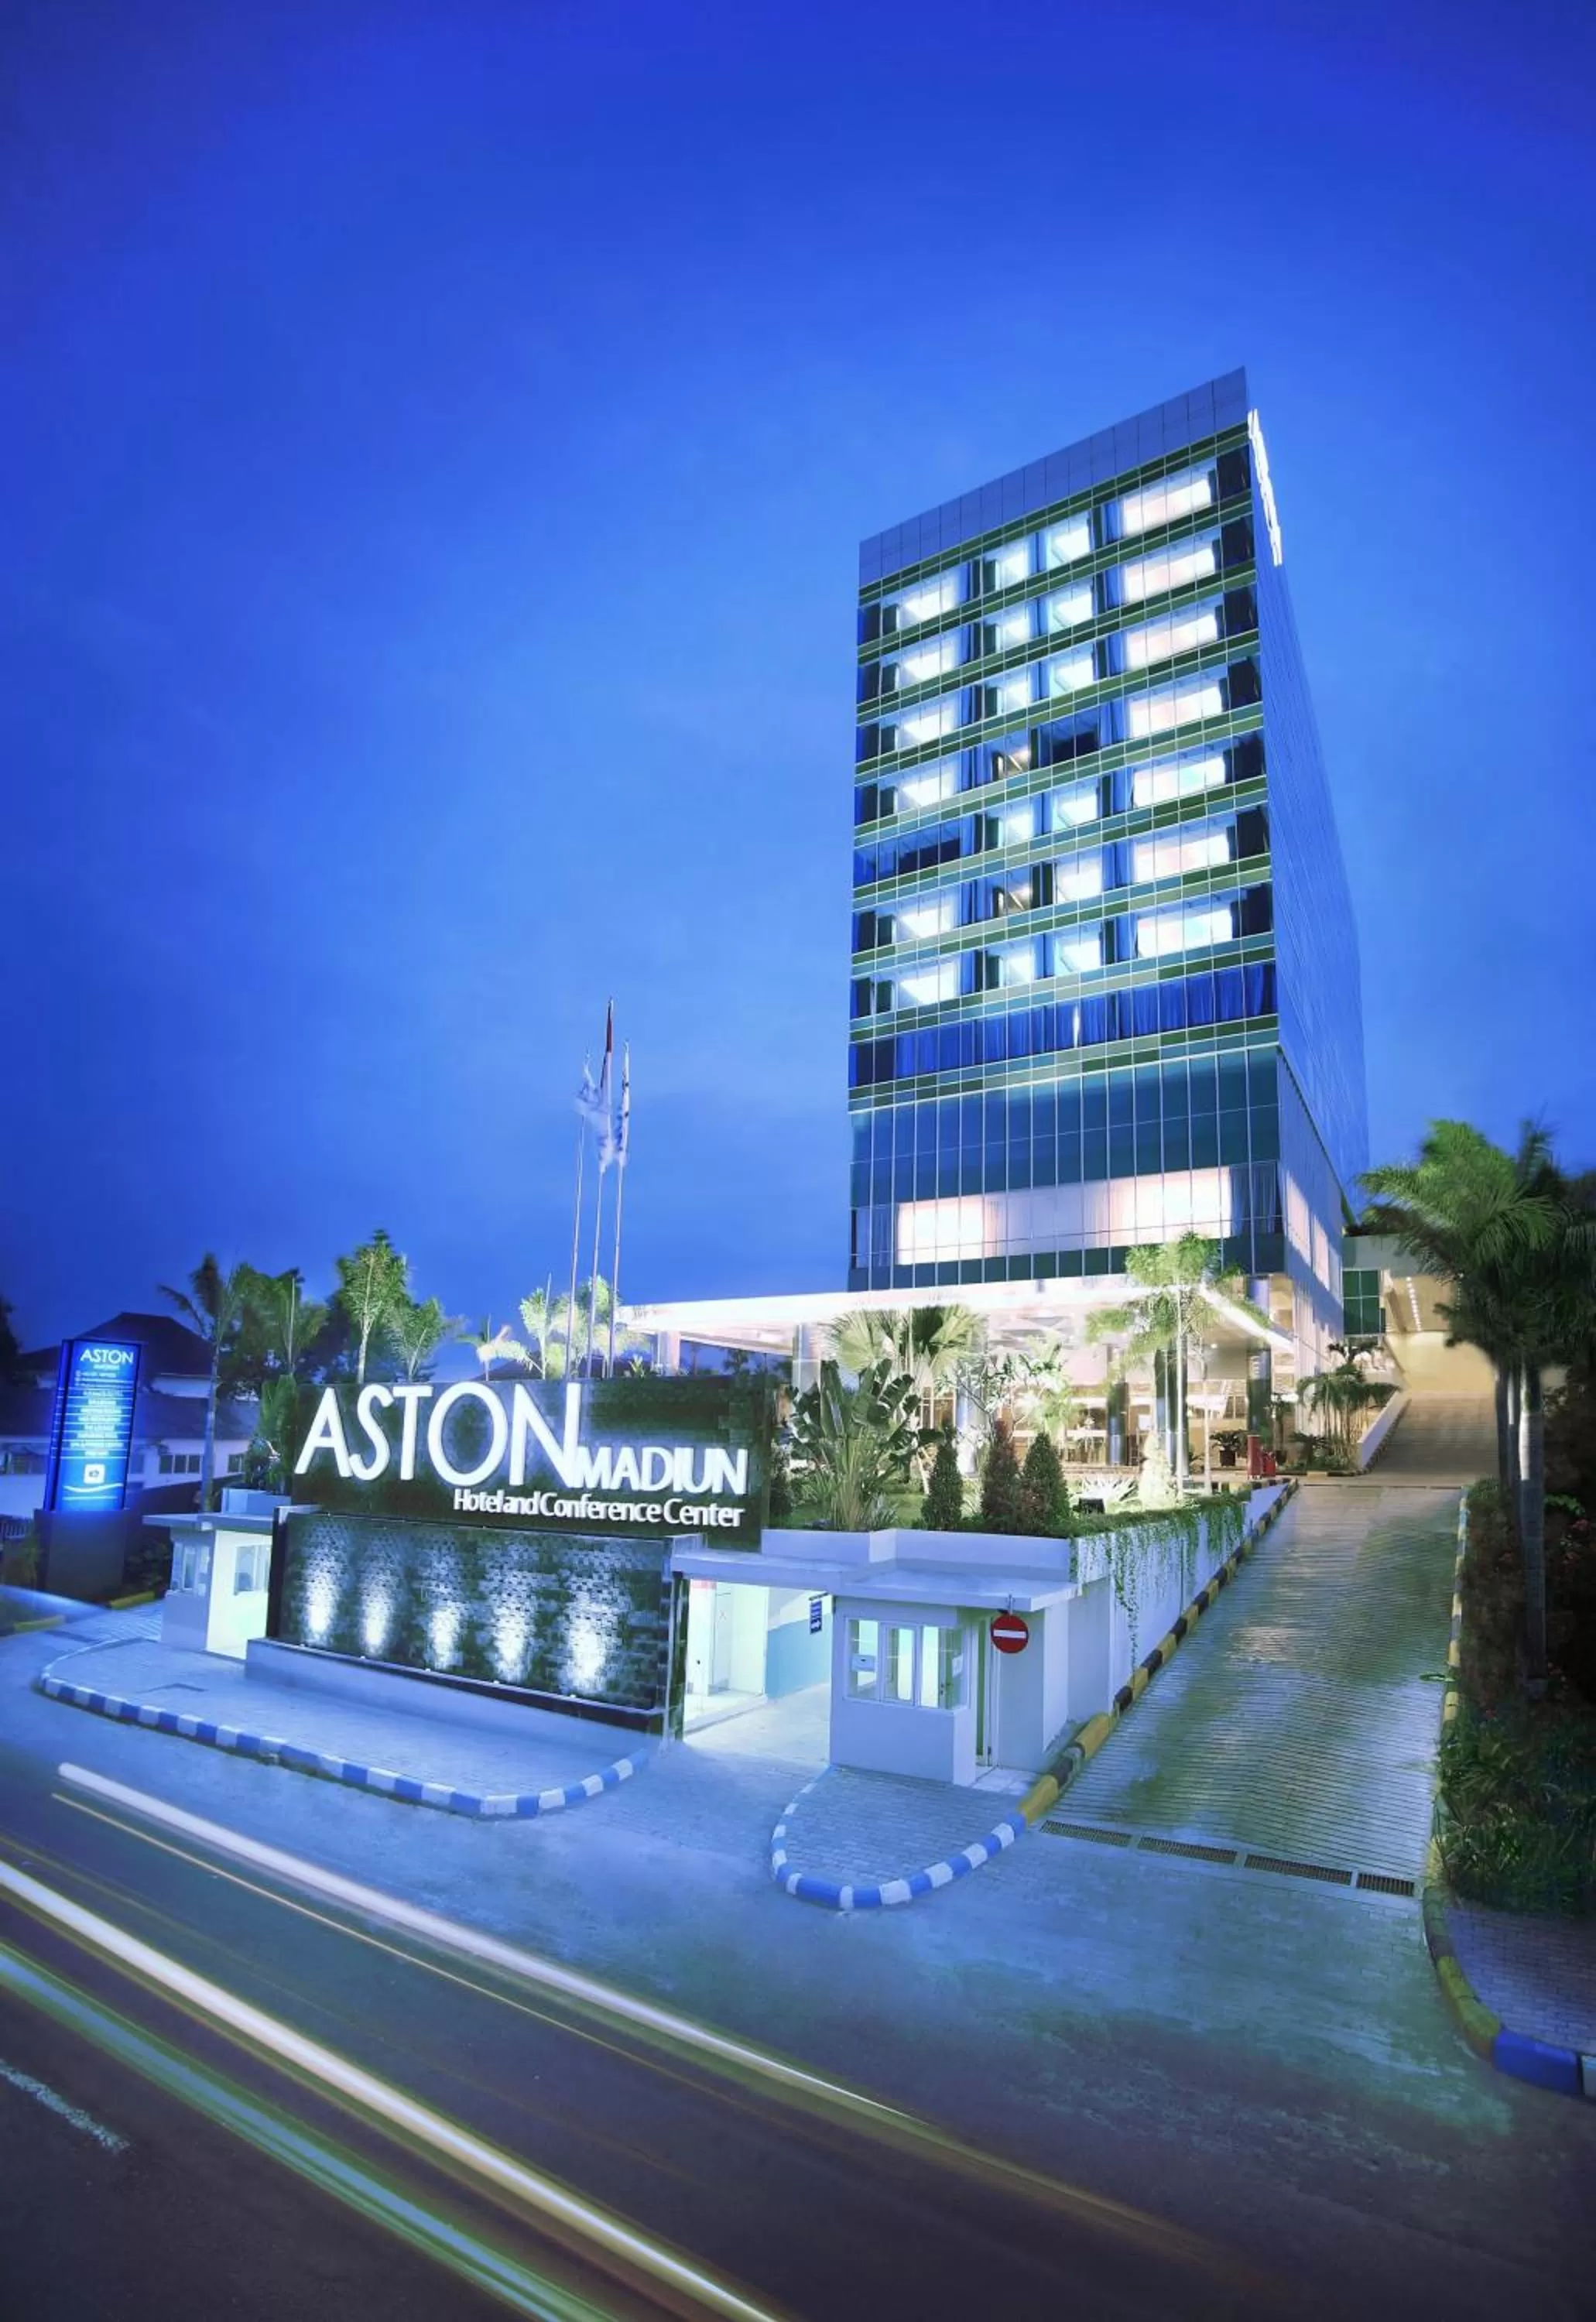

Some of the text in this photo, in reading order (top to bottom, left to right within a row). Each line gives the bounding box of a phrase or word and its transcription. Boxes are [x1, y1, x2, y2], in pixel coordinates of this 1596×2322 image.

[80, 1348, 134, 1365] ASTON
[293, 1382, 748, 1495] ASTON MADIUN
[454, 1488, 746, 1527] Hotel and Conference Center
